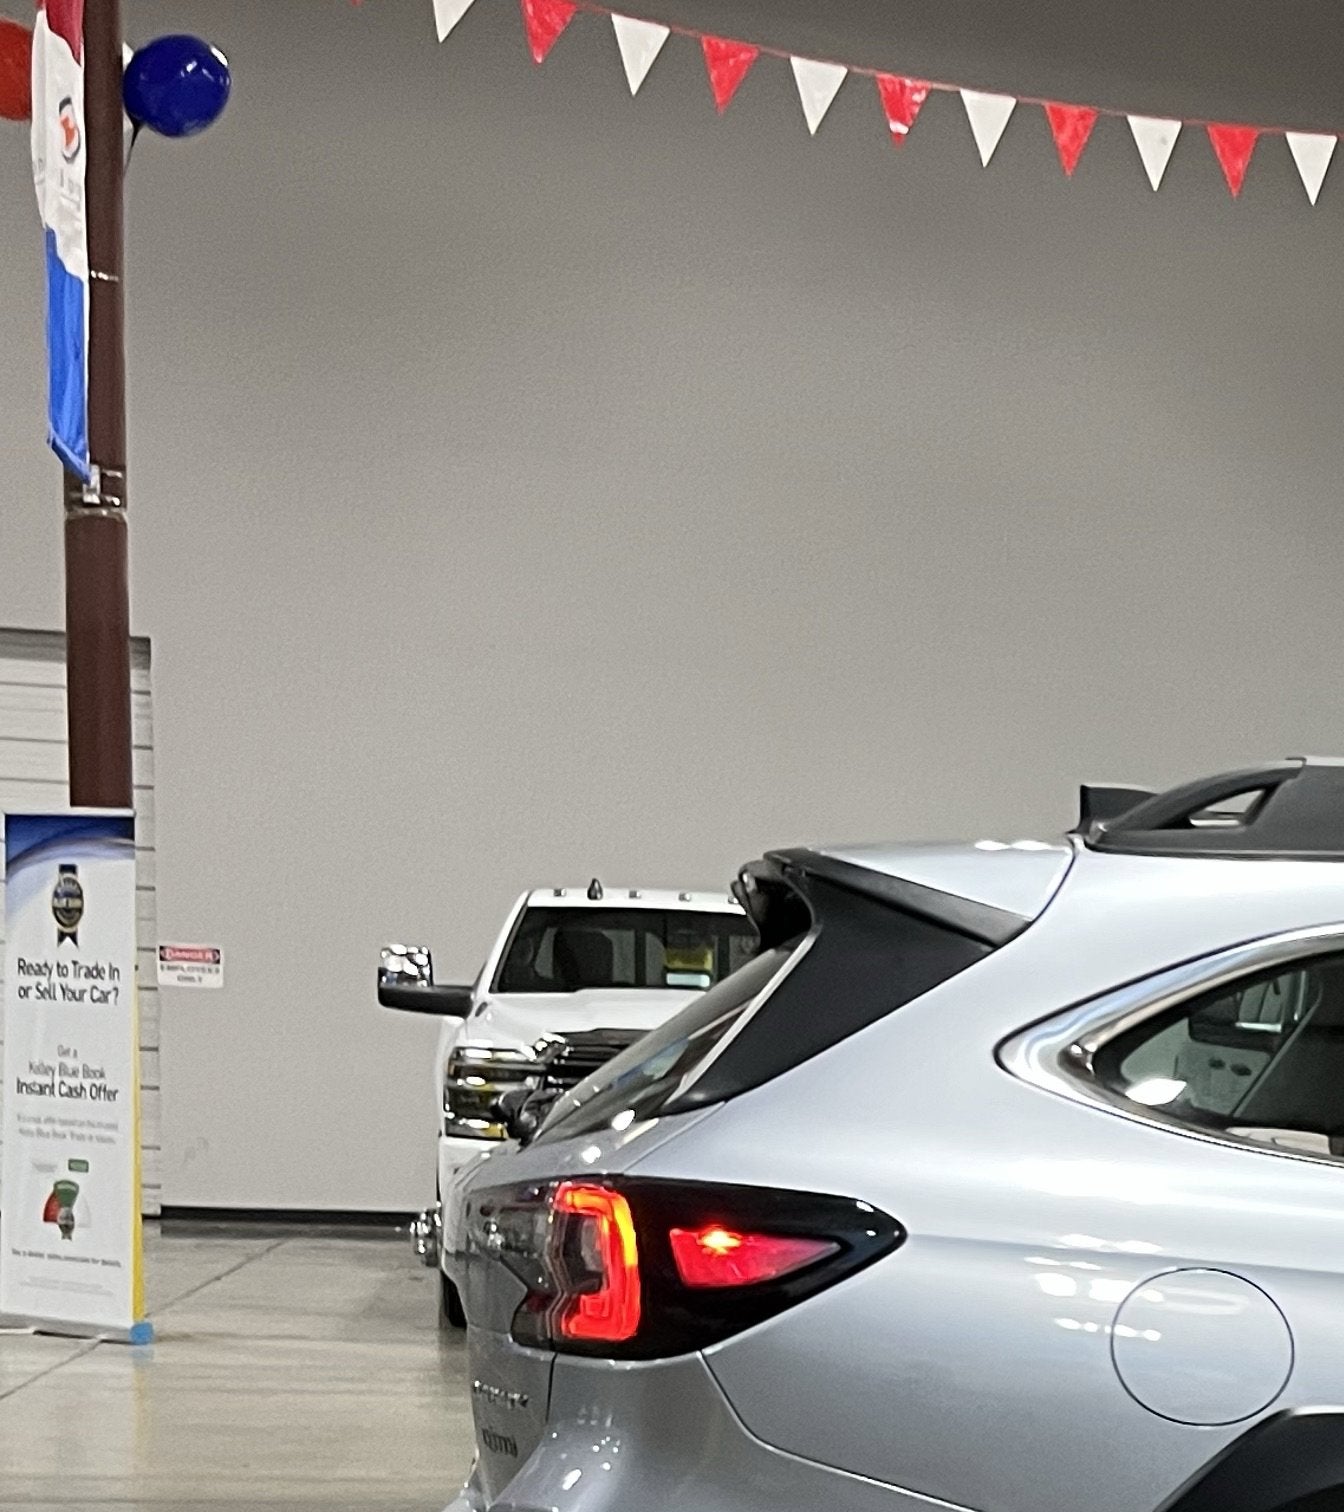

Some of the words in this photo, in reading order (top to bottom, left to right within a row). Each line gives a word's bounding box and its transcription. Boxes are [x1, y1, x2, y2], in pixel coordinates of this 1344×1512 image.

[18, 957, 53, 982] Ready
[57, 961, 69, 979] to
[71, 960, 106, 981] Trade
[109, 962, 121, 983] In
[18, 986, 32, 999] or
[35, 981, 57, 1001] Sell
[60, 982, 88, 1003] Your
[90, 984, 119, 1006] Car?
[16, 1077, 56, 1098] Instant
[58, 1080, 87, 1100] Cash
[90, 1083, 119, 1102] Offer
